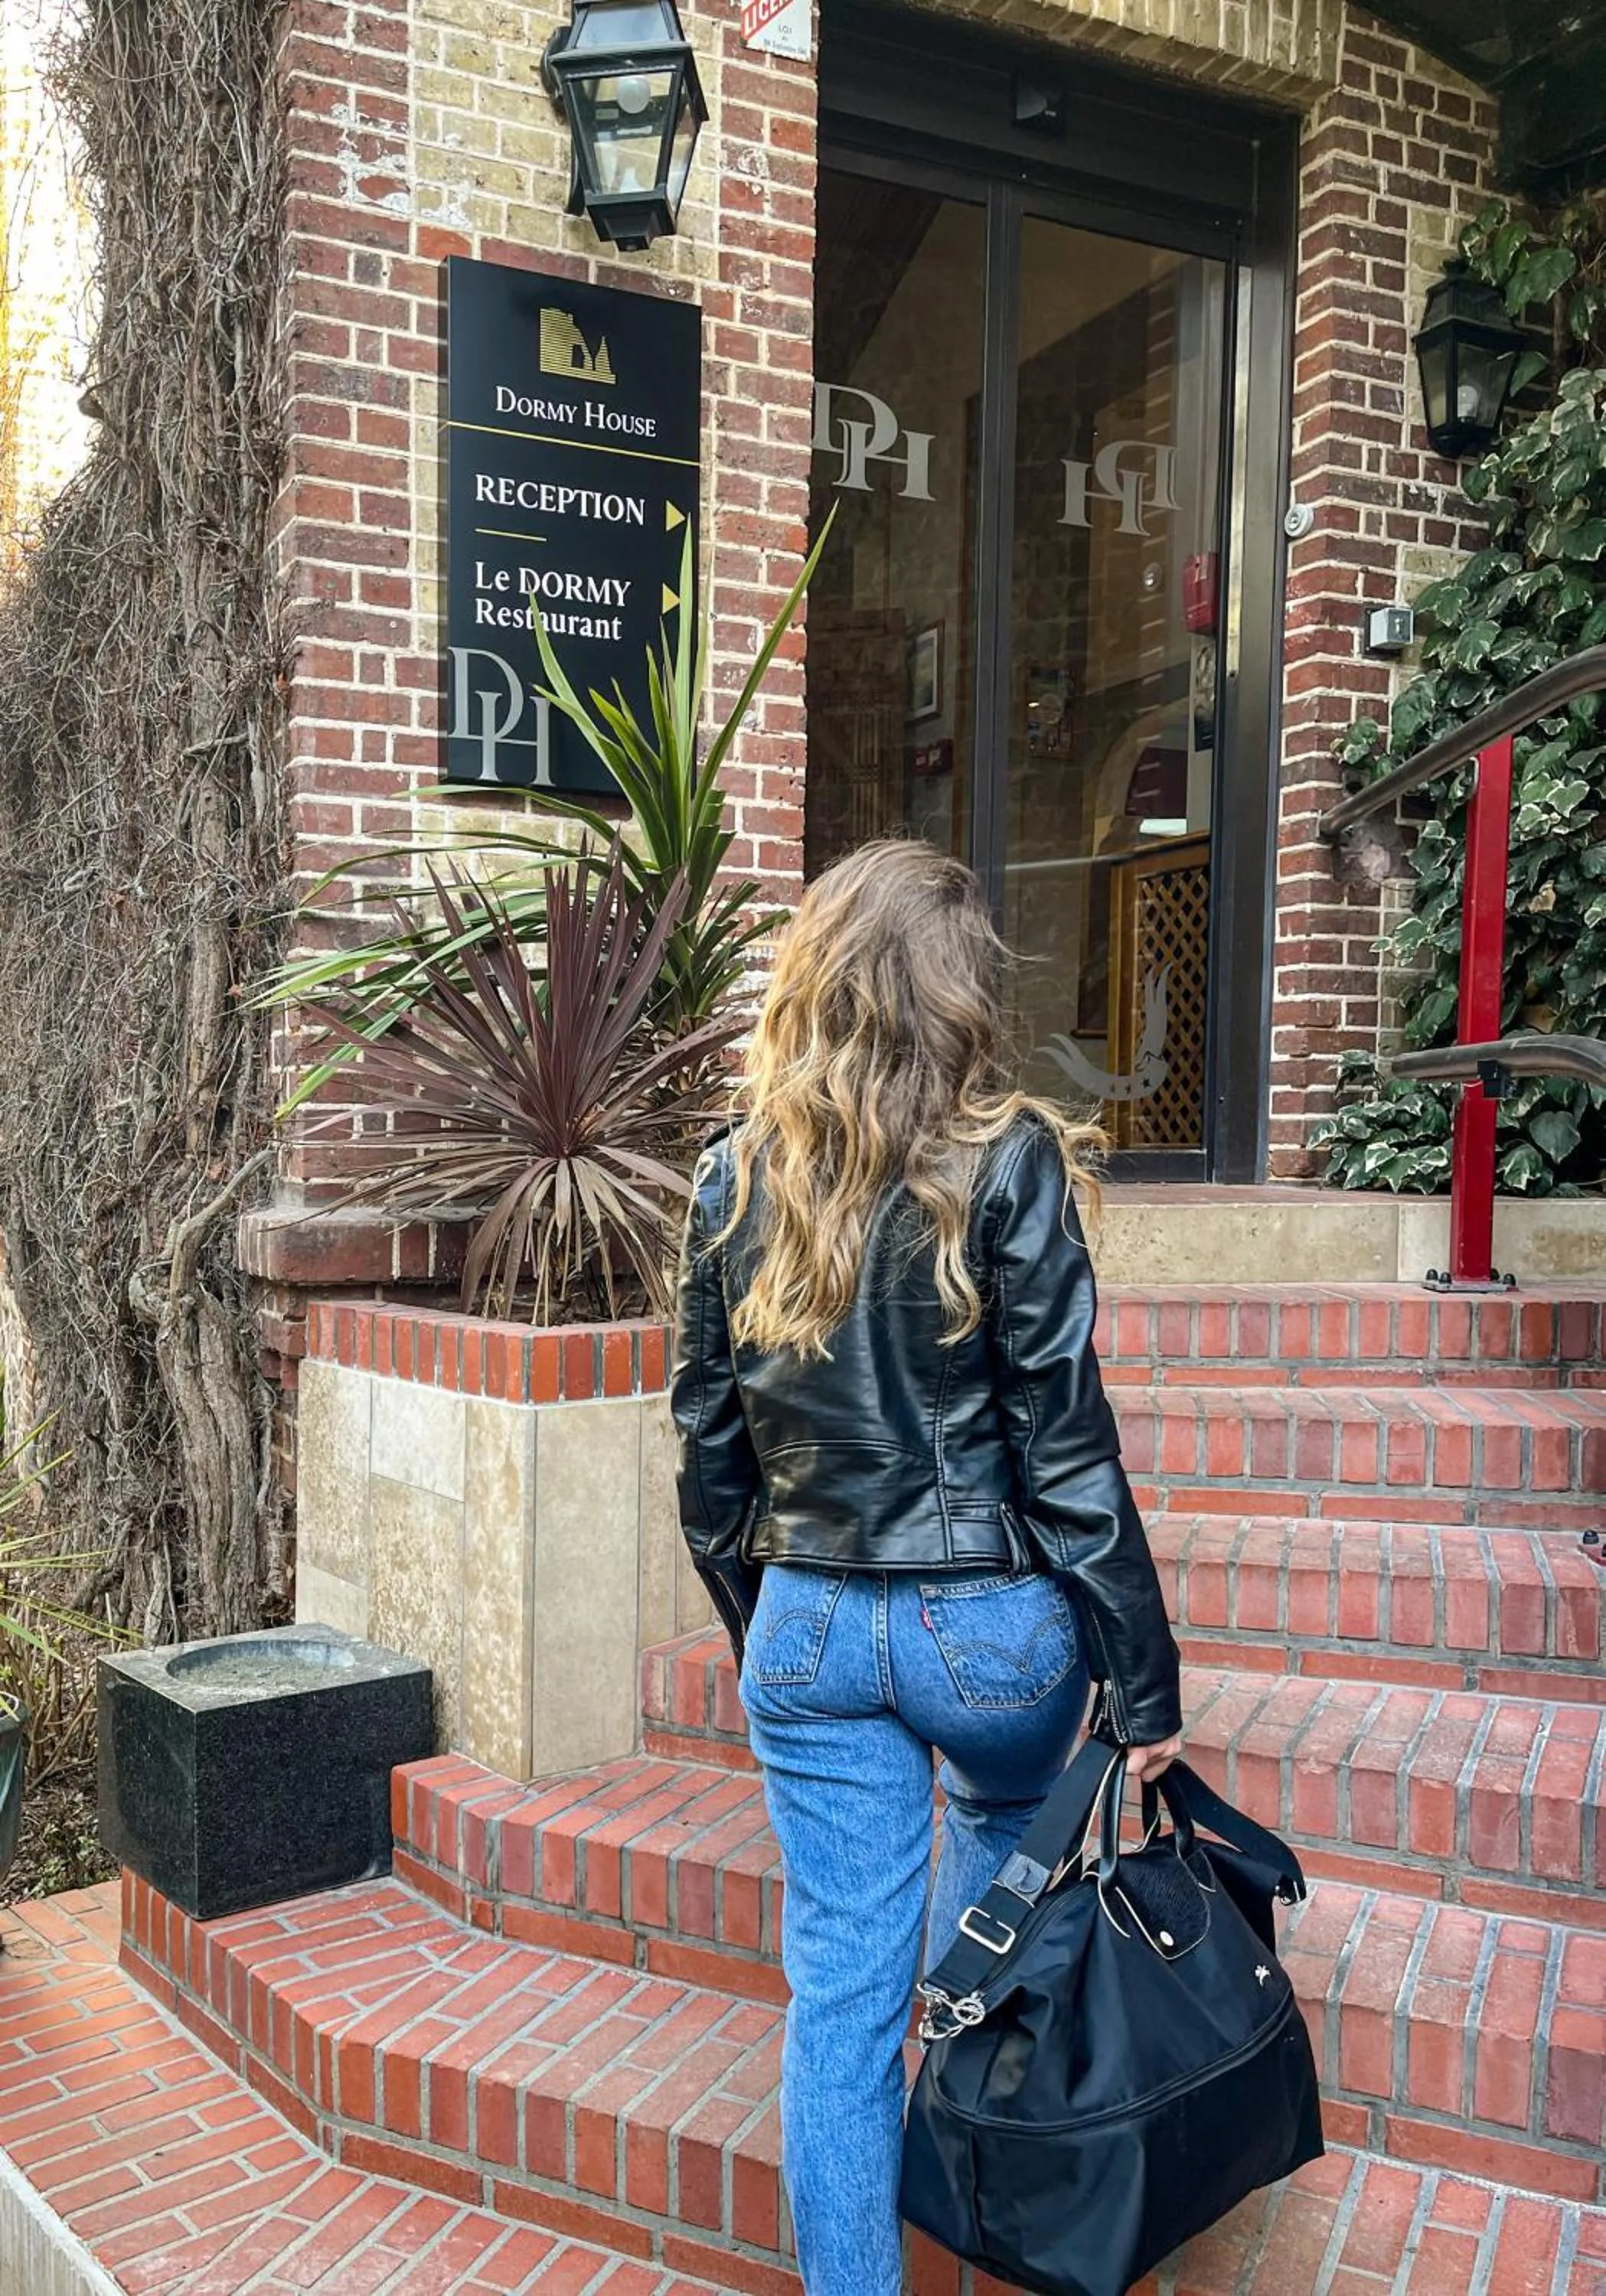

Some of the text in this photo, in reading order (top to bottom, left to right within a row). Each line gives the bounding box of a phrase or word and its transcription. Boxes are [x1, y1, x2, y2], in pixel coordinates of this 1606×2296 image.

[496, 385, 657, 437] DORMY HOUSE
[475, 474, 645, 526] RECEPTION
[475, 561, 632, 607] Le DORMY
[475, 598, 622, 641] Restaurant
